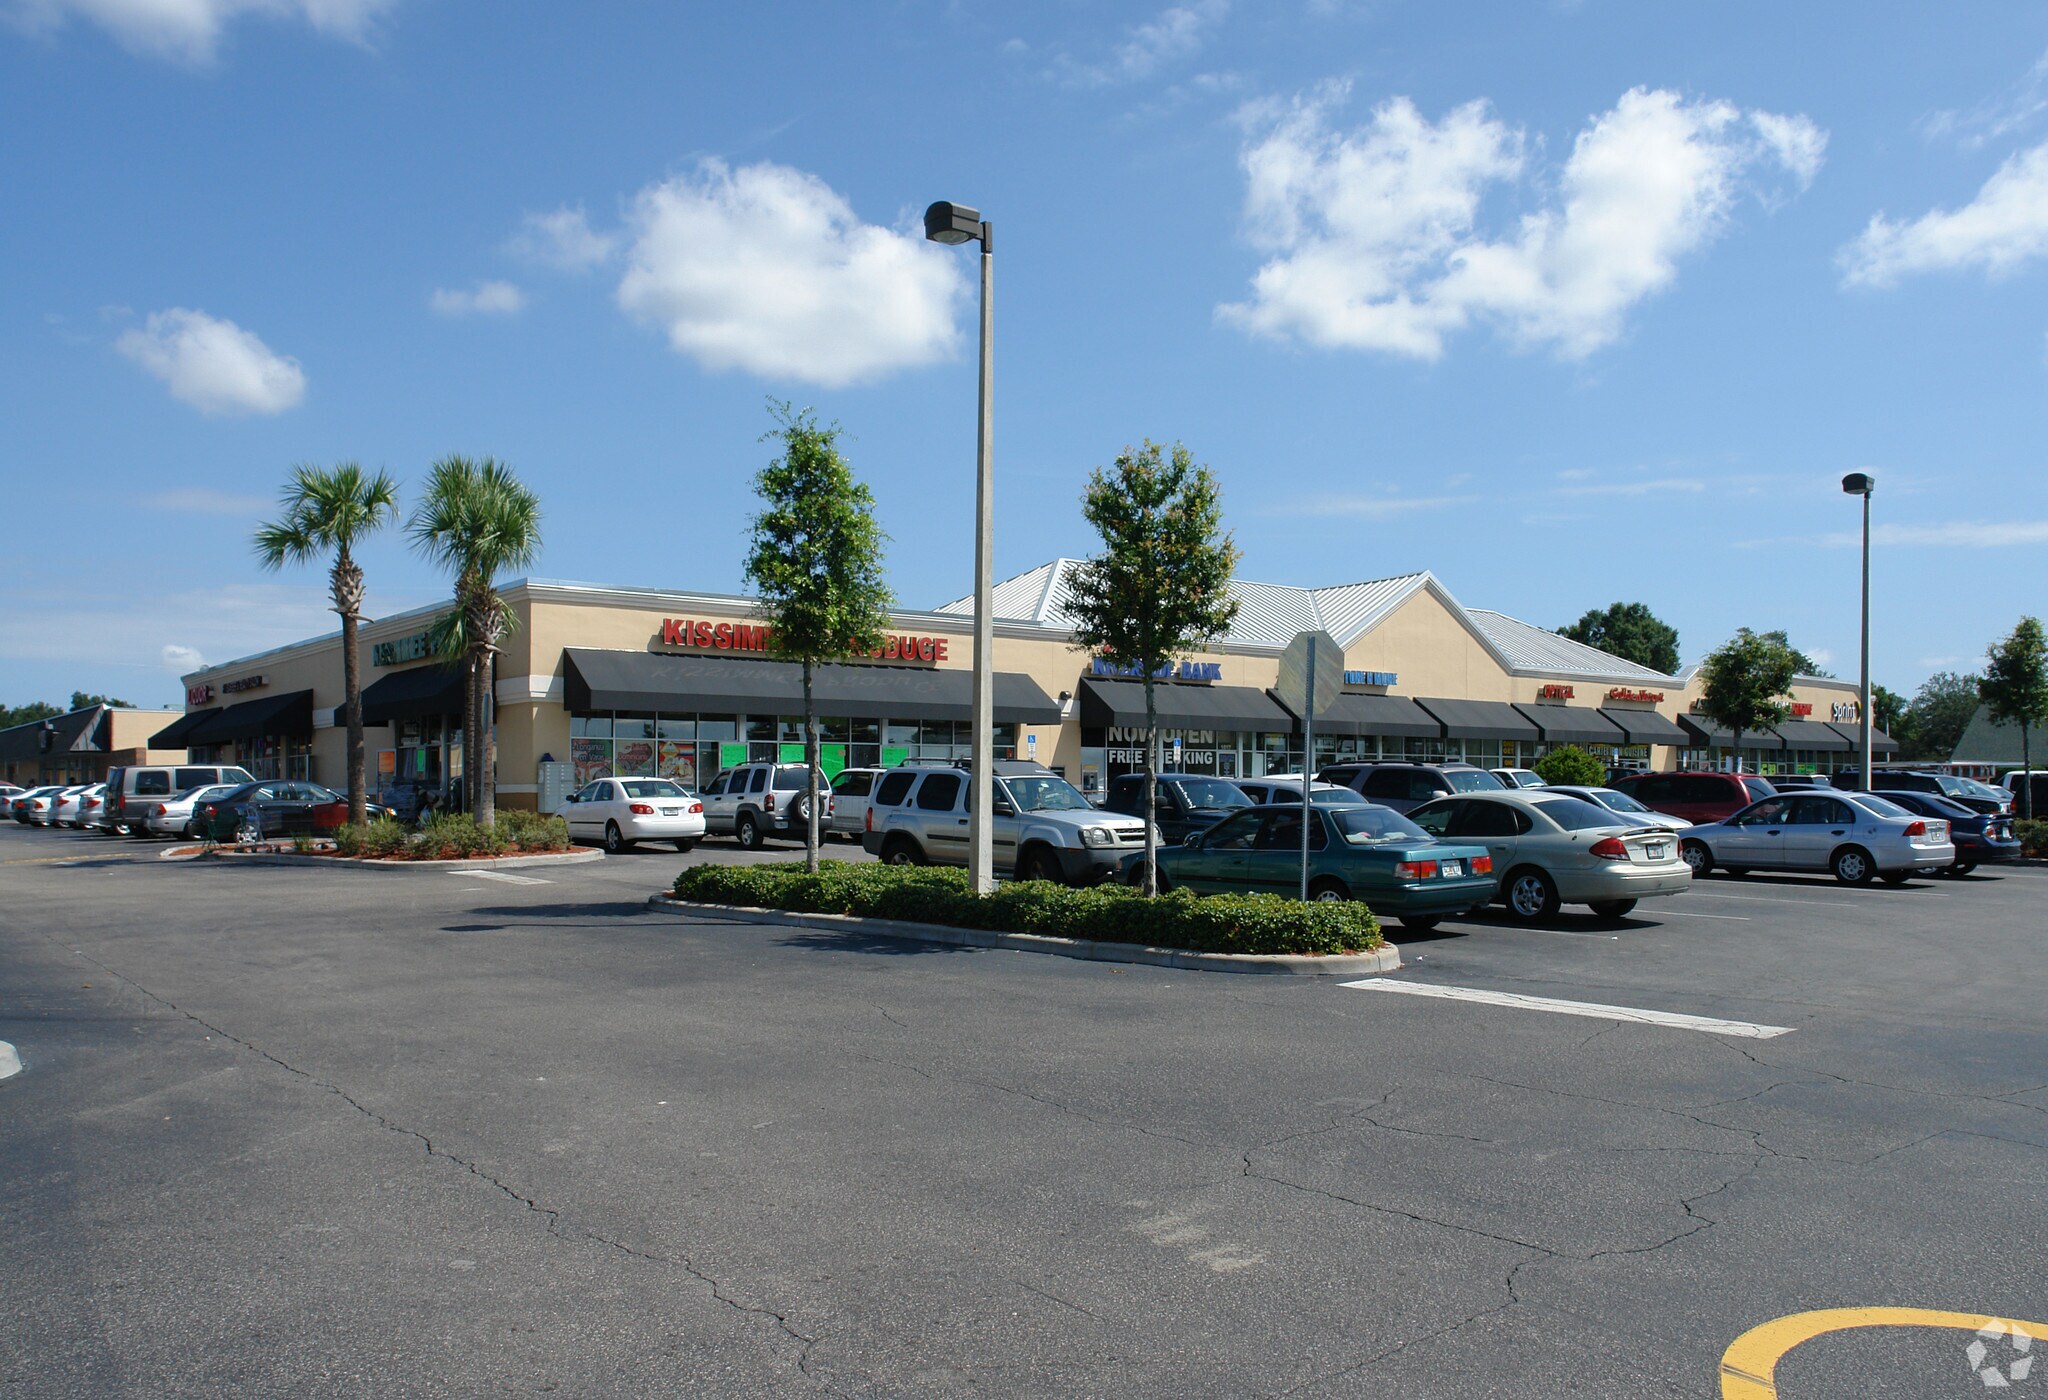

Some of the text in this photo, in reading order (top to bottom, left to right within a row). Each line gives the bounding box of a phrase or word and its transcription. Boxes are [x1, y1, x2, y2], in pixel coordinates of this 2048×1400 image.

[663, 618, 949, 661] KISSIM RODUCE
[1180, 661, 1222, 680] BANK
[1543, 684, 1575, 699] OPTICAL
[1833, 701, 1856, 722] Sprint
[1108, 750, 1143, 764] FREE
[1160, 751, 1214, 765] EKING
